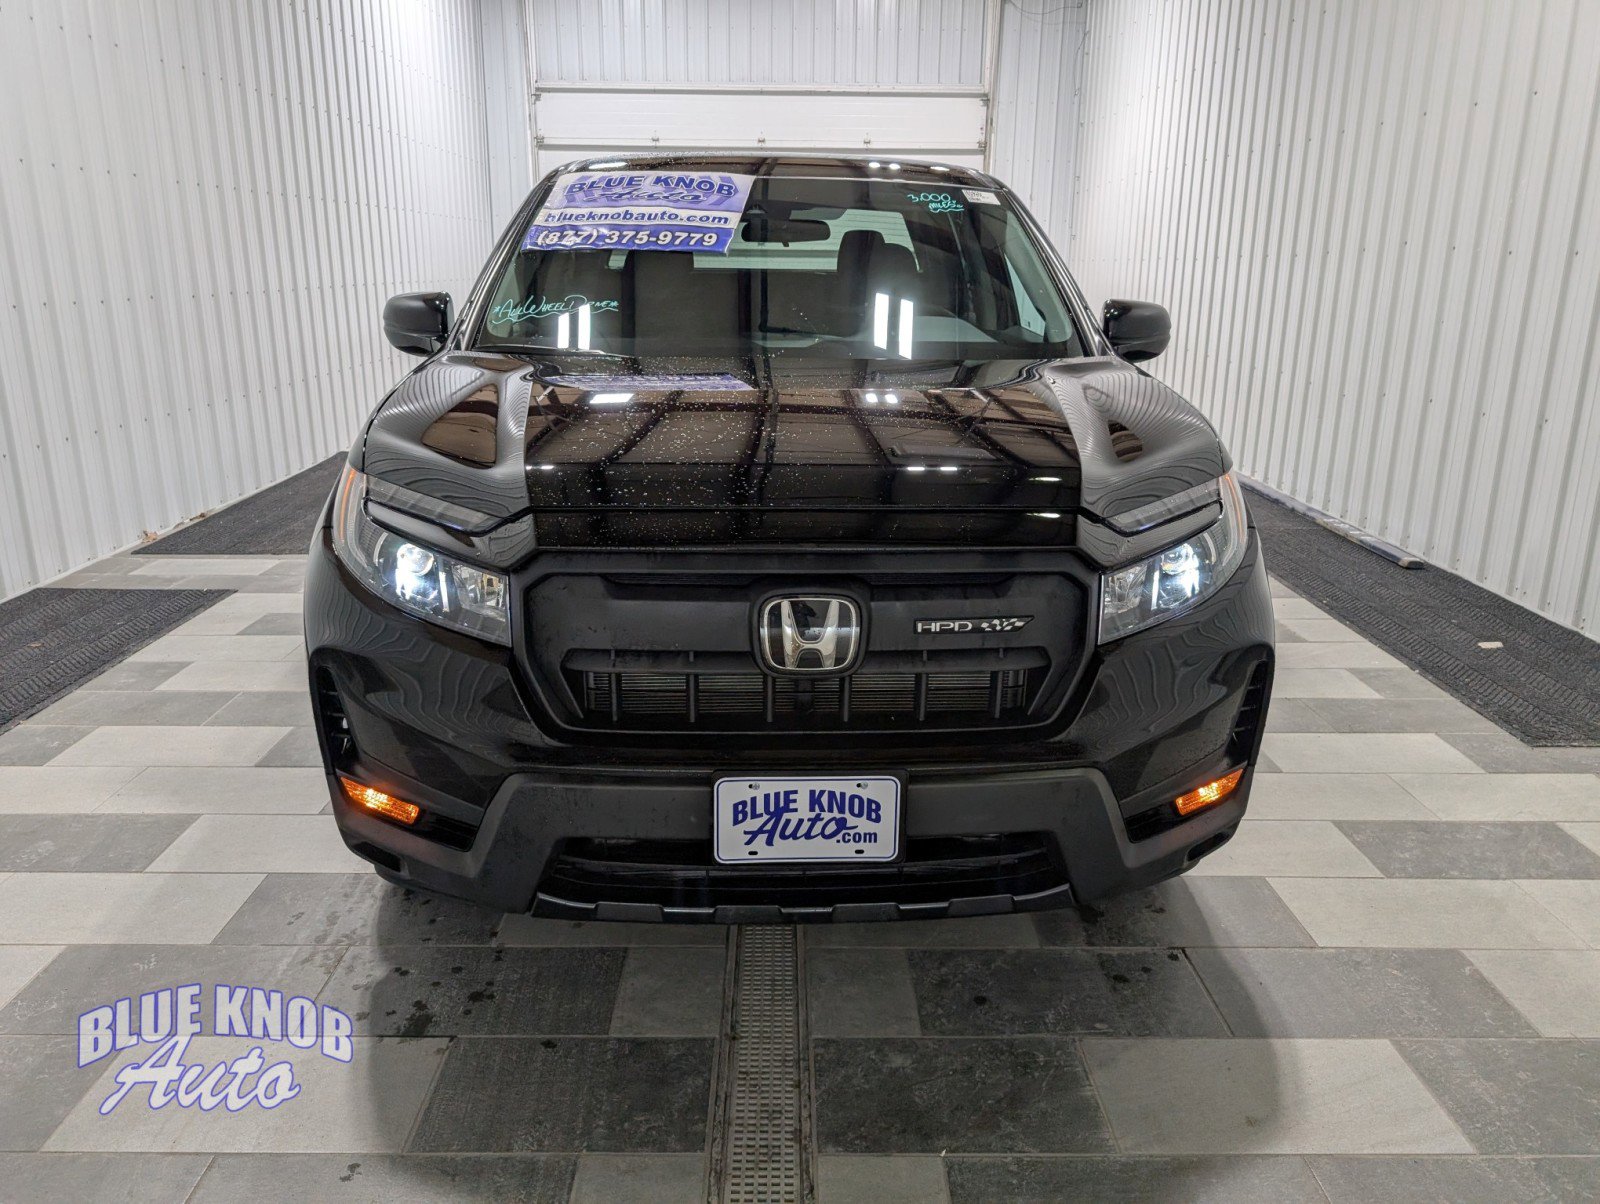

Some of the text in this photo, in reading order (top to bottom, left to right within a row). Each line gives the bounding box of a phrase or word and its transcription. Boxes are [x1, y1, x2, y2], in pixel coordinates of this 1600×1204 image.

[565, 174, 737, 198] BLUE KNOB
[544, 209, 729, 226] blueknobauto.com
[604, 230, 718, 247] 375-9779
[917, 620, 973, 633] HPD
[732, 789, 882, 827] BLUE KNOB
[743, 812, 859, 847] Auto
